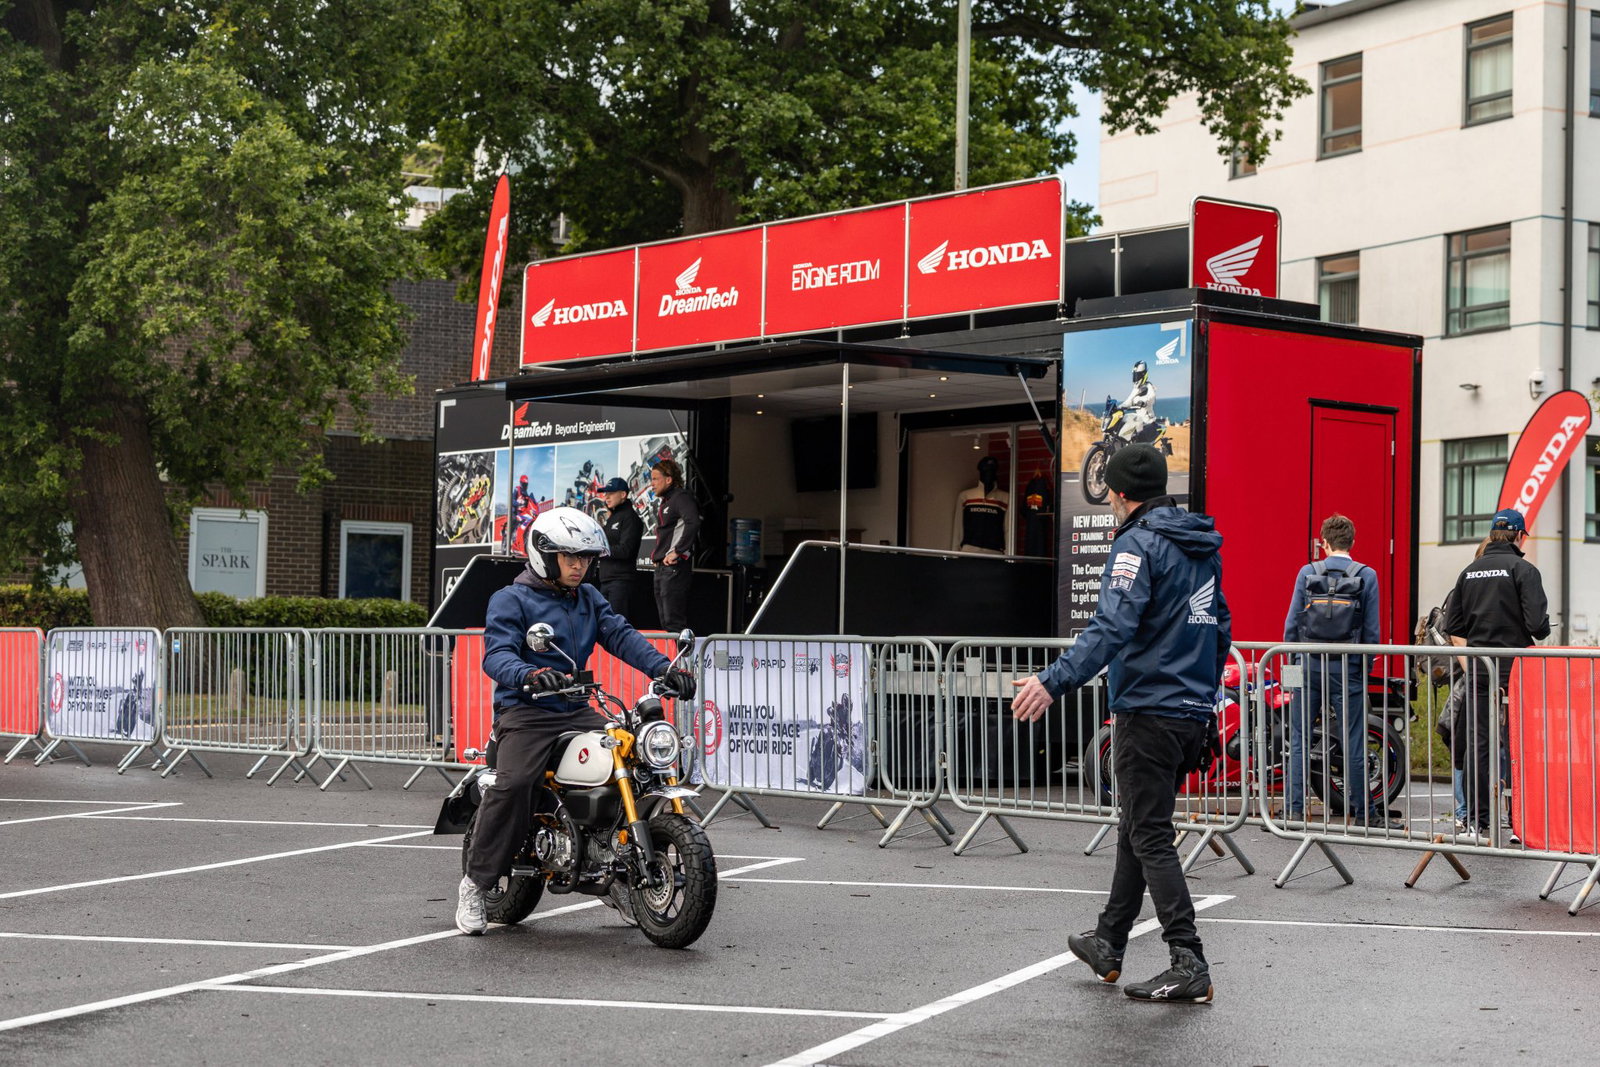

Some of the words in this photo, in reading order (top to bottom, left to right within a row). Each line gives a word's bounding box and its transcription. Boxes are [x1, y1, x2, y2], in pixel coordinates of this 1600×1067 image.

[947, 239, 1052, 271] HONDA
[480, 212, 509, 380] ONDA
[675, 286, 702, 297] HONDA
[658, 287, 739, 317] DreamTech
[553, 300, 628, 325] HONDA
[1156, 357, 1180, 366] HONDA
[501, 421, 552, 440] DeamTech
[555, 423, 578, 436] Beyond
[579, 420, 616, 435] Engineering
[1073, 515, 1090, 528] NEW
[1091, 514, 1114, 528] RIDER
[1080, 532, 1104, 541] TRAINING
[1080, 545, 1112, 553] MOTORCYCLE
[202, 553, 250, 569] SPARK
[1072, 564, 1084, 575] The
[1466, 569, 1509, 579] HONDA
[1072, 579, 1101, 593] Everythin
[1071, 593, 1078, 602] to
[1079, 593, 1090, 605] get
[1090, 594, 1099, 602] on
[1071, 609, 1083, 619] Chat
[1083, 610, 1089, 619] to
[1187, 615, 1218, 625] HONDA
[761, 659, 786, 669] RAPID
[68, 676, 85, 687] WTH
[729, 705, 752, 719] WITH
[755, 705, 775, 719] YOU
[729, 722, 740, 735] AT
[772, 723, 800, 738] STAGE
[729, 739, 741, 753] OF
[743, 740, 767, 754] YOUR
[772, 741, 792, 755] RIDE
